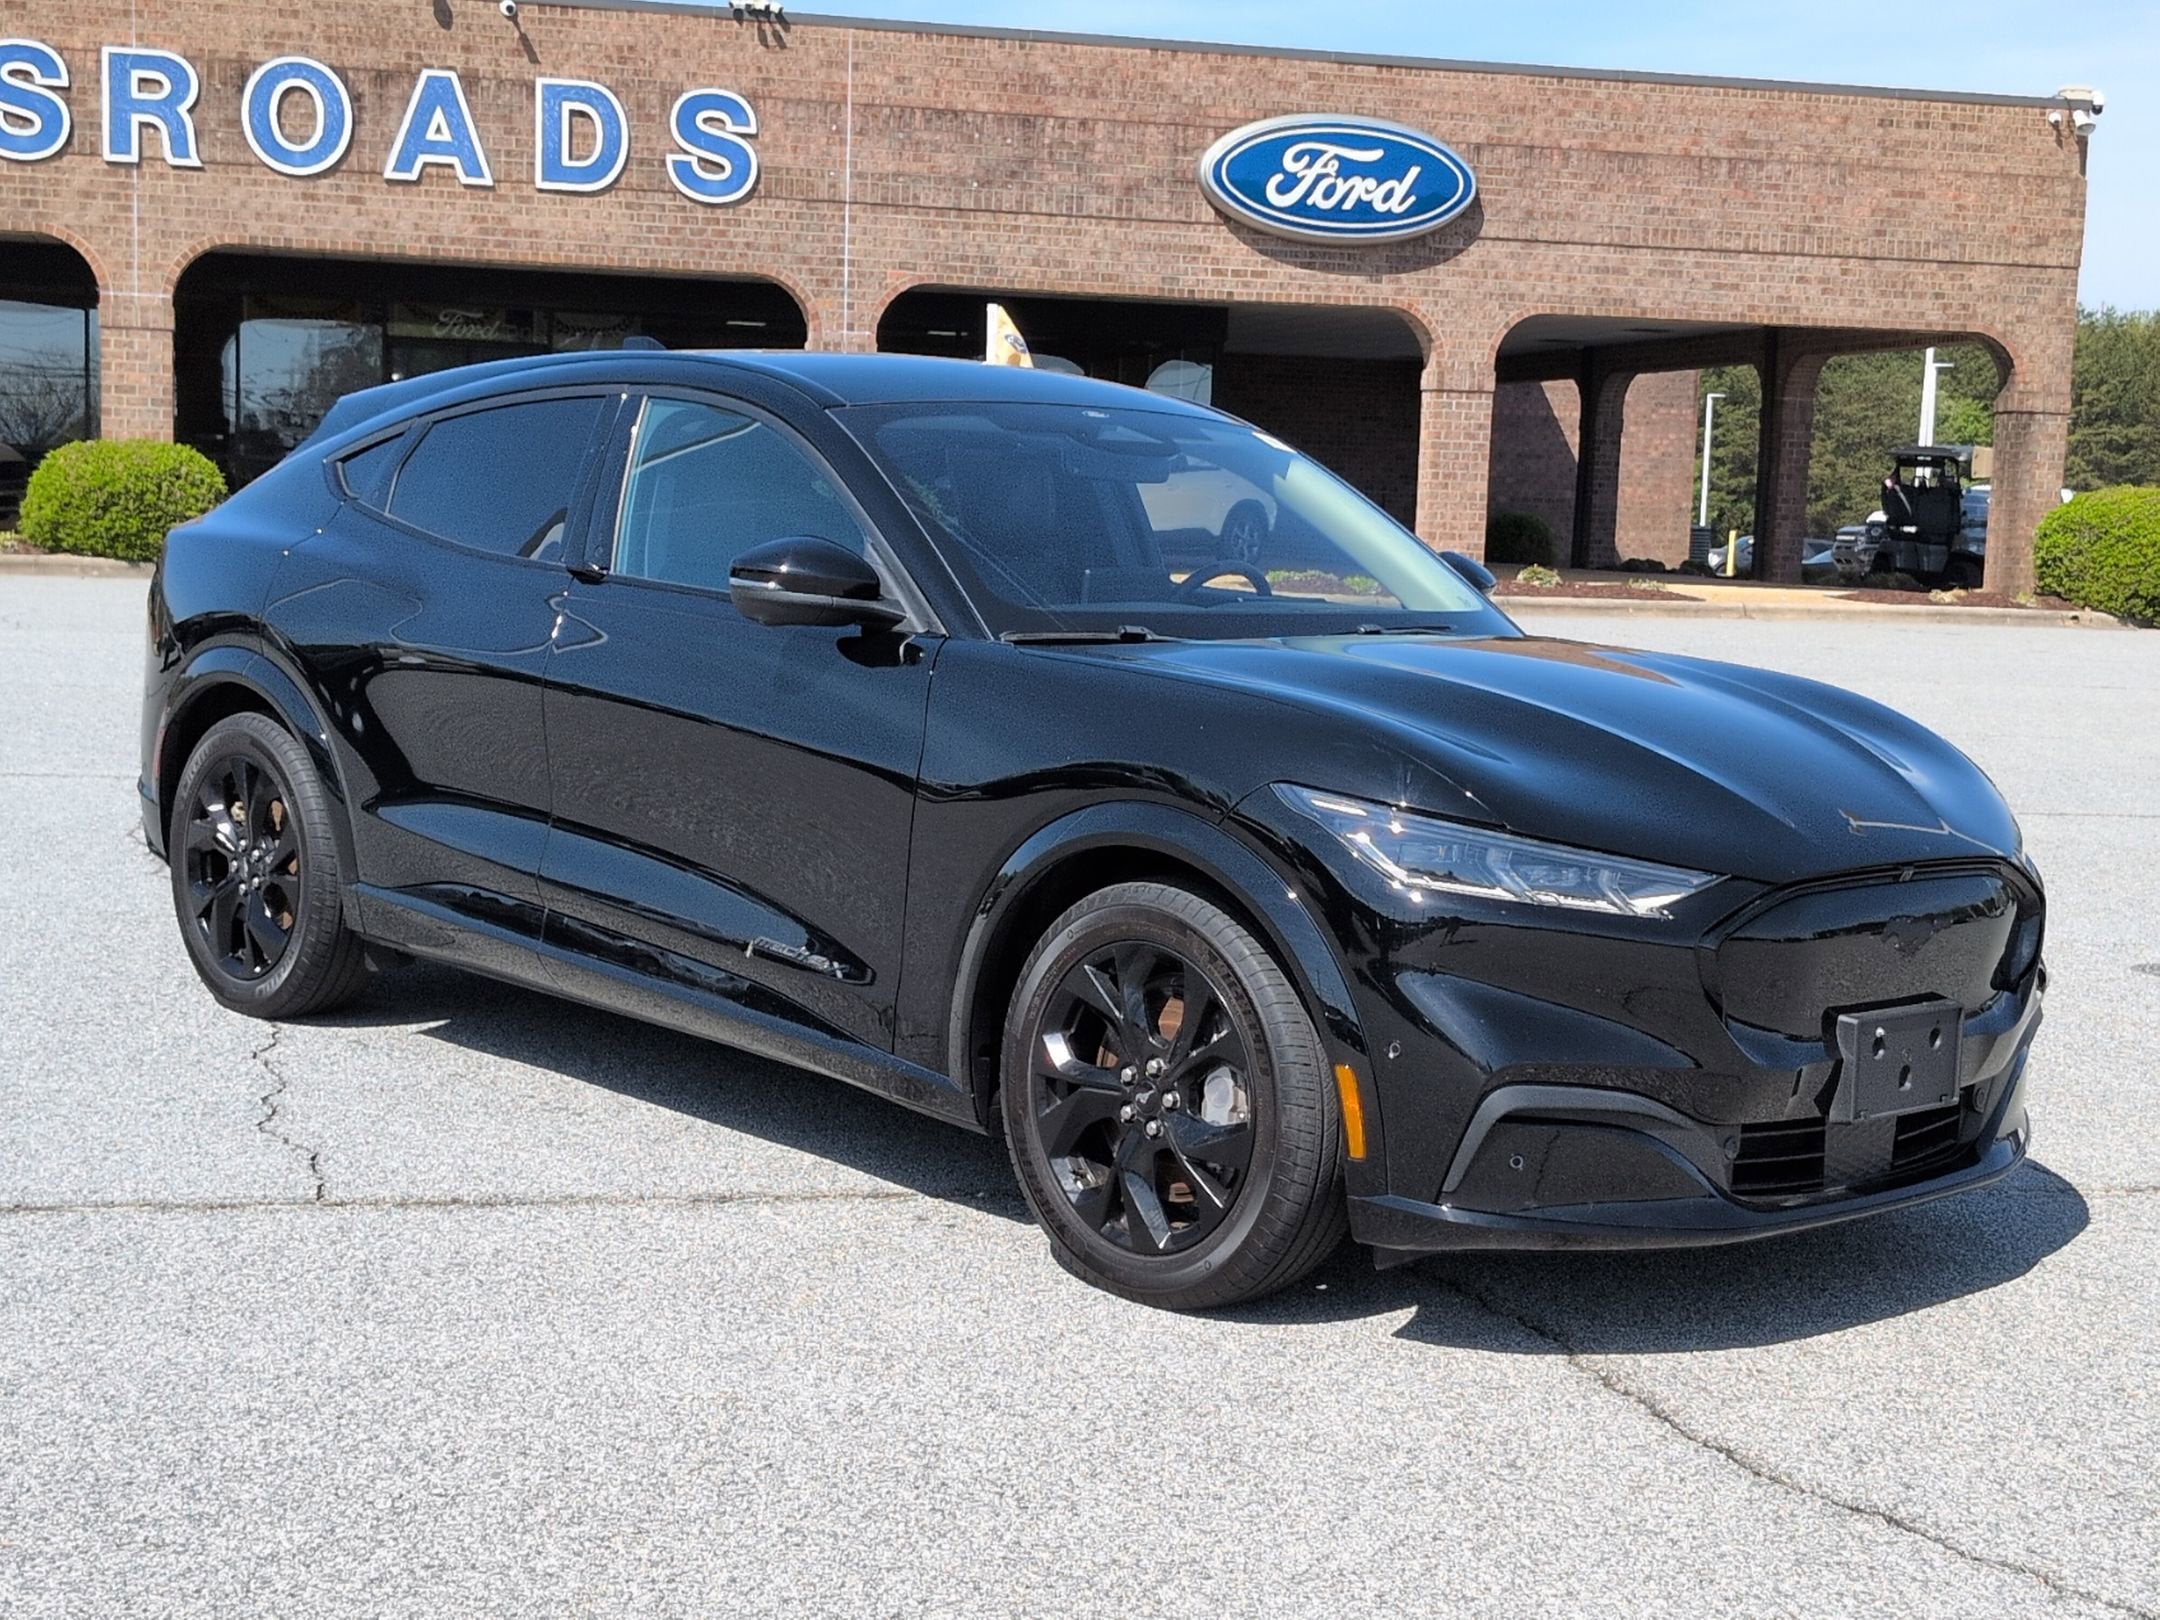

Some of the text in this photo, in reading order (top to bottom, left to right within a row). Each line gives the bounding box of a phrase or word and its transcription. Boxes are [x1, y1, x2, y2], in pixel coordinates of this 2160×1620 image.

[0, 38, 760, 204] SROADS
[1265, 141, 1422, 214] Ford
[432, 308, 500, 340] Ford
